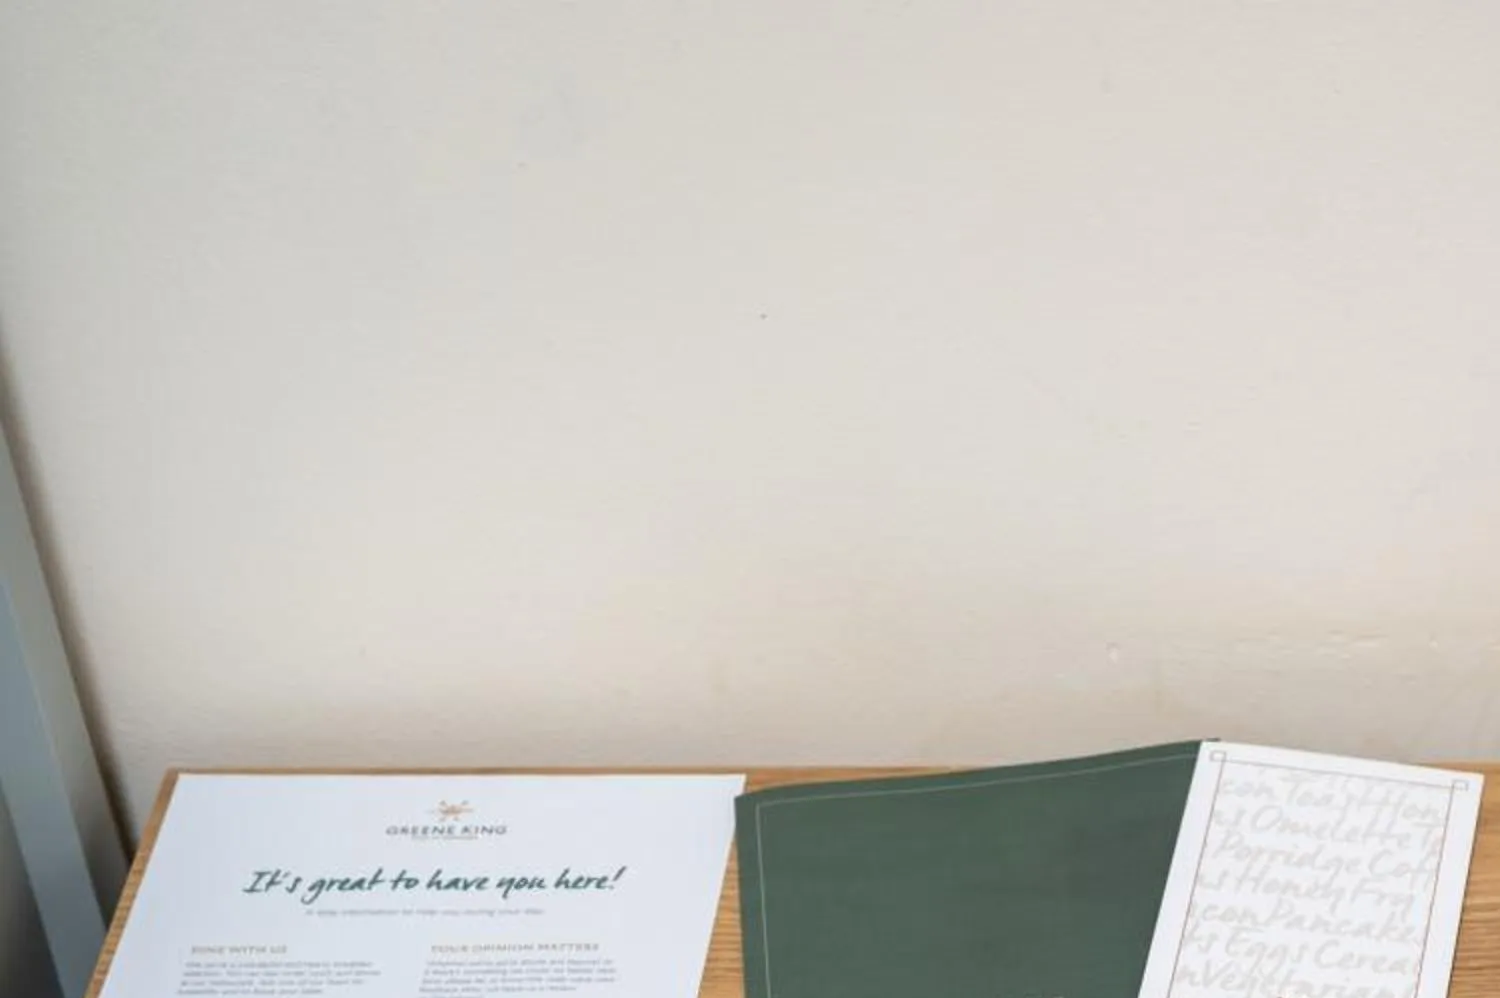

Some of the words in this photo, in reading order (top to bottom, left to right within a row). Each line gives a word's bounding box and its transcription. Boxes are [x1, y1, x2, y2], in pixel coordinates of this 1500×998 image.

[385, 825, 455, 836] GREENE
[460, 825, 507, 836] KING
[242, 868, 303, 894] It's
[300, 867, 387, 905] great
[389, 869, 420, 891] to
[425, 867, 491, 891] have
[496, 875, 549, 900] you
[553, 865, 628, 890] here!
